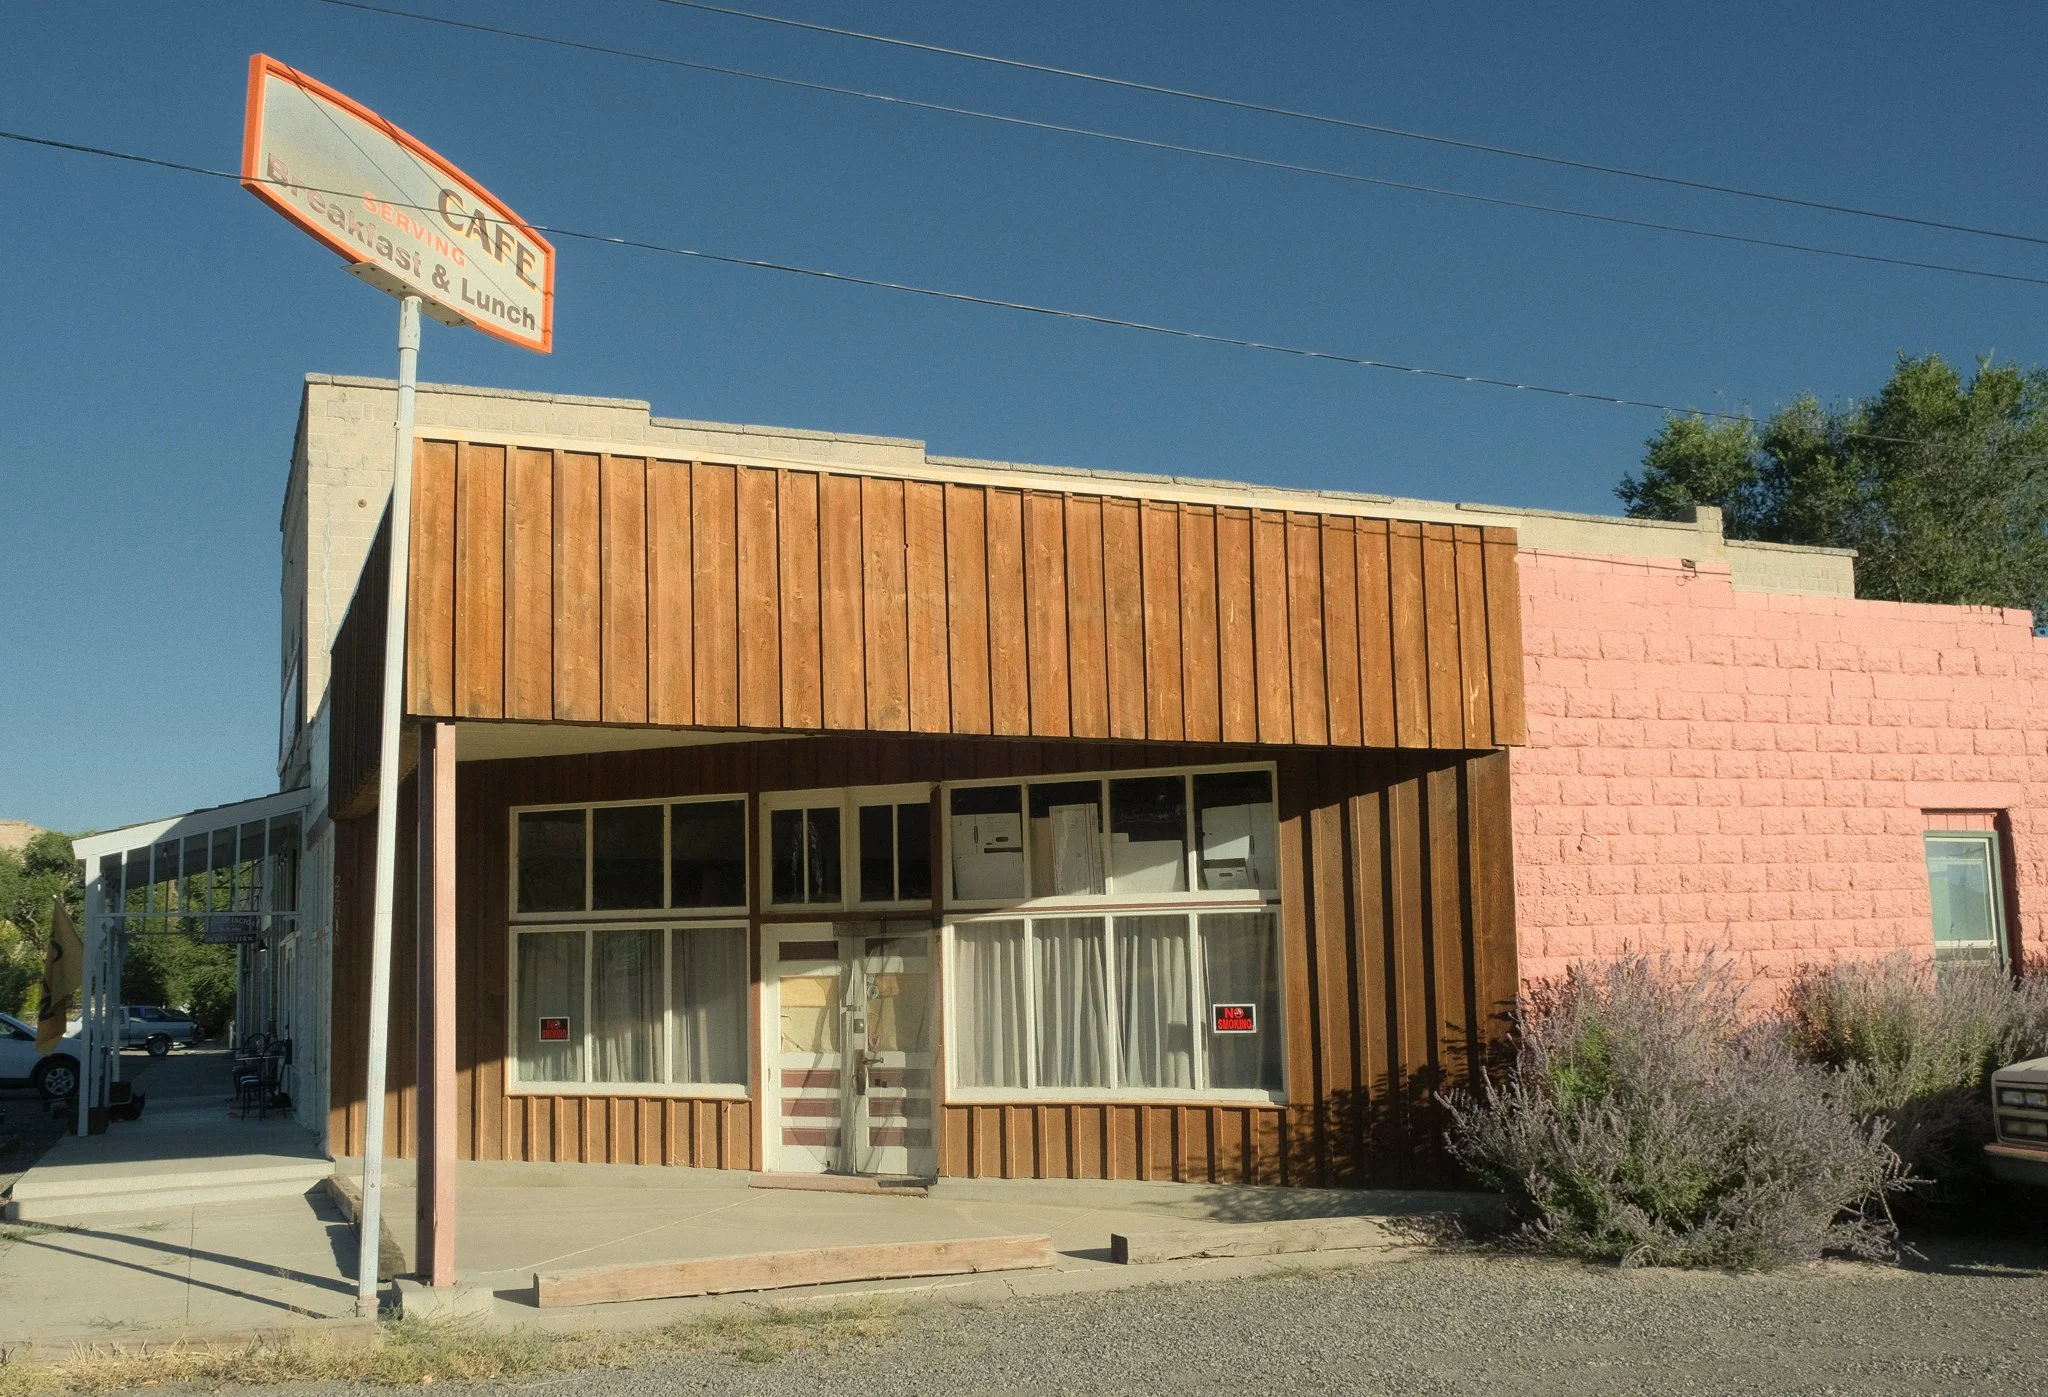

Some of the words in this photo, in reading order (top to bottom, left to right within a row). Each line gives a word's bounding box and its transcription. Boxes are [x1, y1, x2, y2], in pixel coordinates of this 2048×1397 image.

[266, 151, 422, 278] Breakfast
[431, 263, 451, 294] &
[461, 277, 536, 331] Lunch
[361, 190, 467, 268] SERVING
[437, 188, 538, 291] CAFE
[1217, 1019, 1252, 1029] SMOKING
[1224, 1007, 1244, 1018] NO
